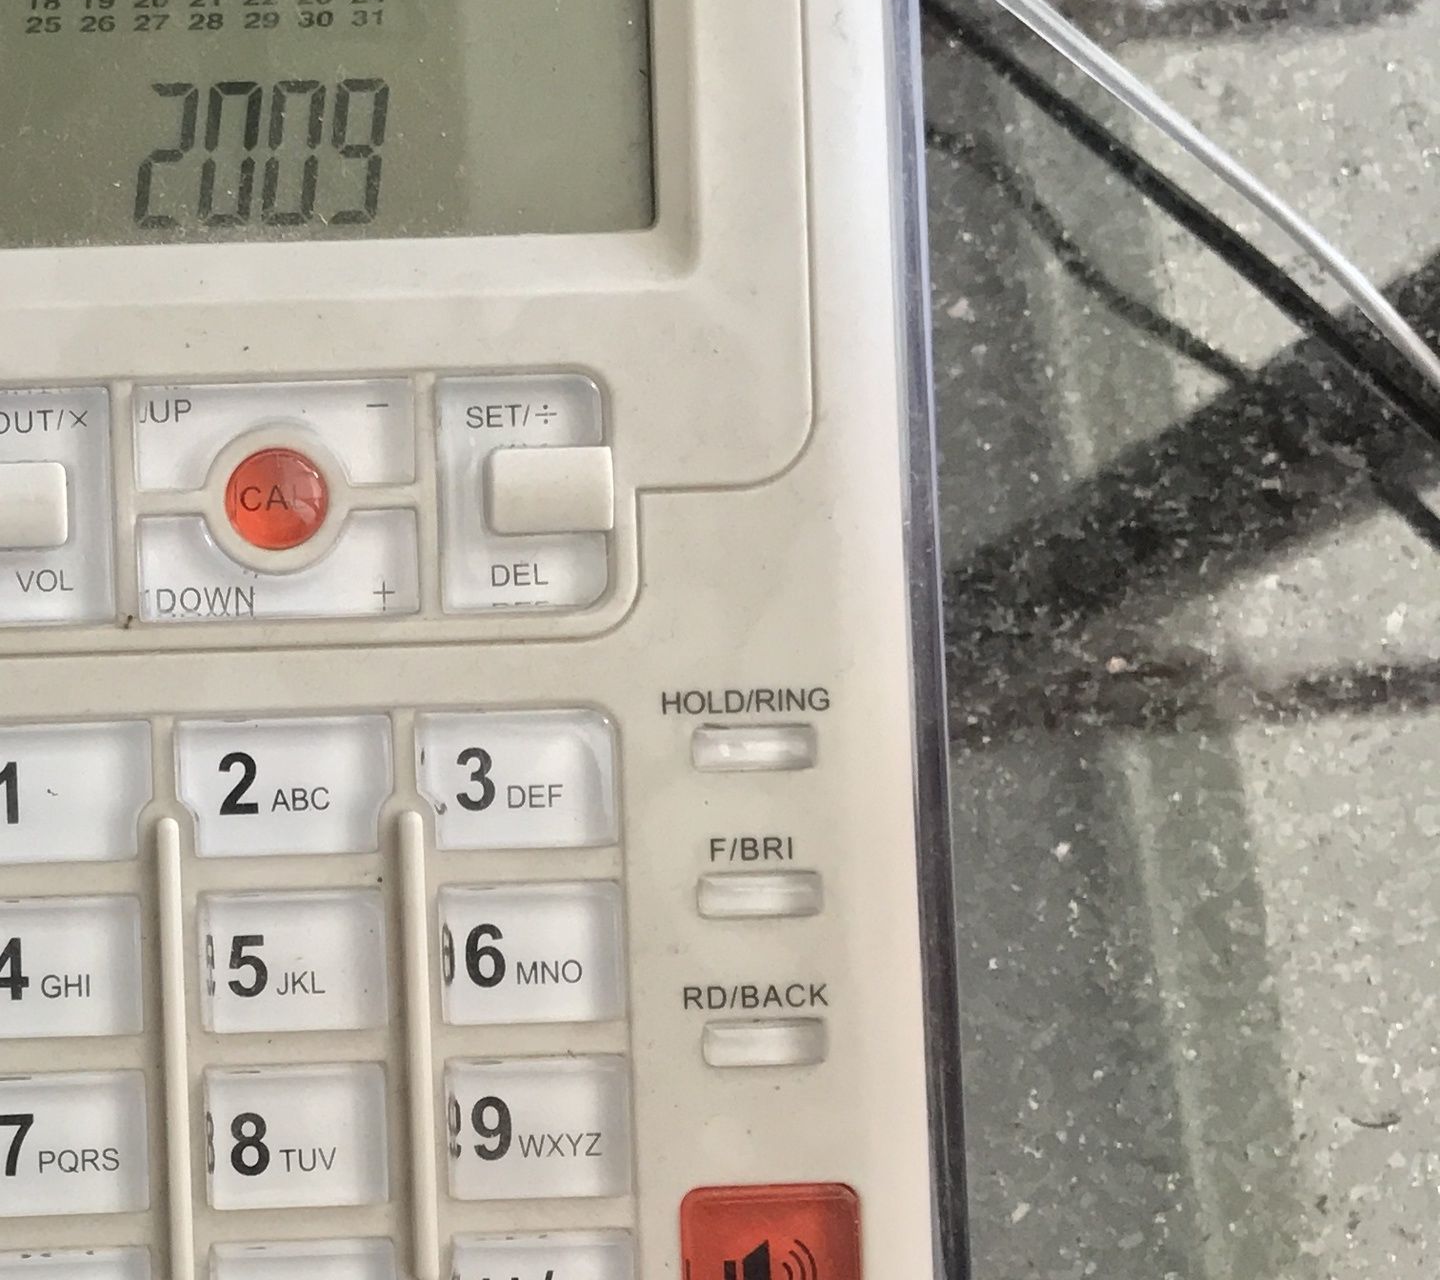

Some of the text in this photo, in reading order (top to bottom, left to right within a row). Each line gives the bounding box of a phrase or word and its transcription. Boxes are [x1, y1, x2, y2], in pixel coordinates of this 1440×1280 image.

[25, 9, 384, 34] 25 26 27 28 29 30 31
[134, 78, 389, 227] 2009
[150, 399, 191, 424] UP
[15, 569, 73, 594] VOL
[491, 563, 548, 587] DEL
[157, 587, 255, 614] DOWN
[661, 688, 830, 715] HOLD/RING
[218, 752, 330, 816] 2 ABC
[456, 747, 563, 810] 3 DEF
[710, 837, 793, 862] F/BRI
[227, 934, 325, 997] 5 JKL
[465, 924, 582, 987] 6 MNO
[40, 974, 91, 998] GHI
[683, 983, 828, 1010] RD/BACK
[471, 1096, 602, 1160] 9 WXYZ
[230, 1112, 337, 1176] 8 TUV
[38, 1148, 119, 1174] PQRS
